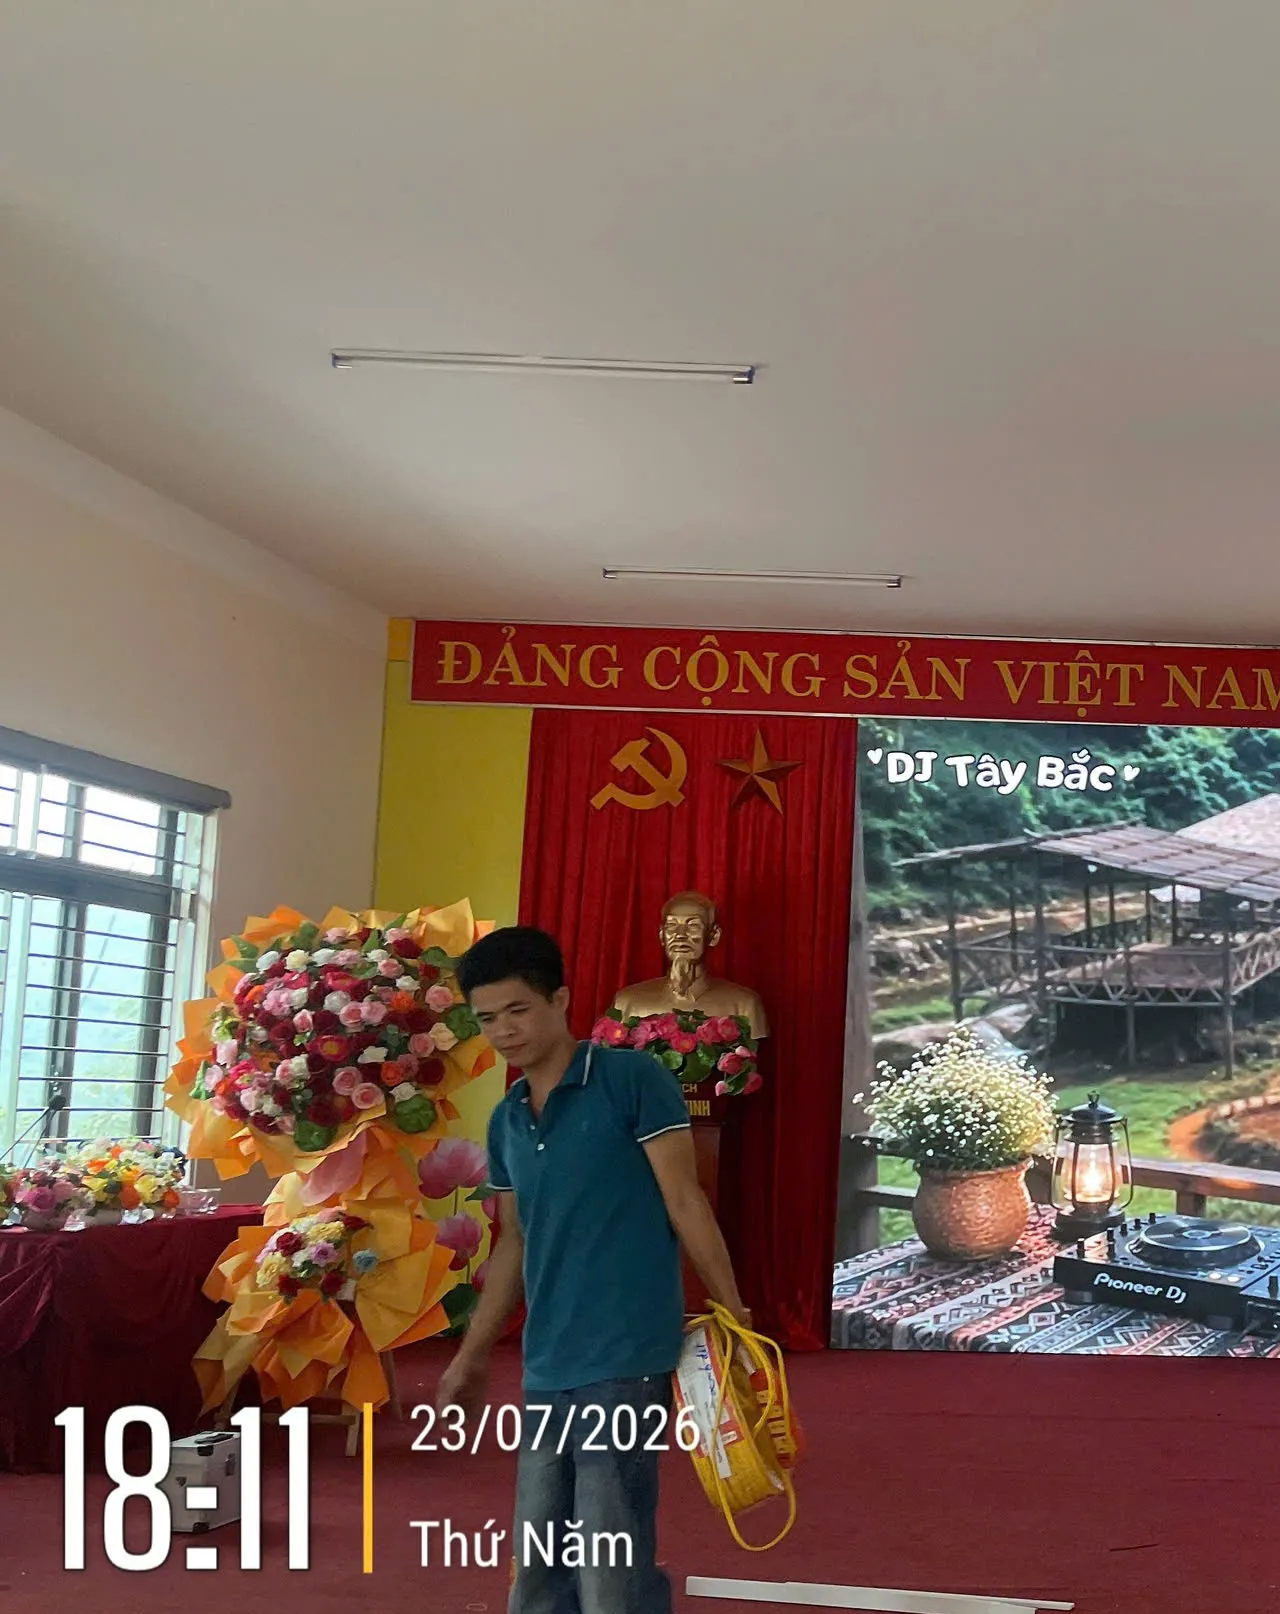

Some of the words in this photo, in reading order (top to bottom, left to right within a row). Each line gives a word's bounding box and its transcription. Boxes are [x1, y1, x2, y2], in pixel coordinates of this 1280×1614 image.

[438, 626, 623, 689] ĐẢNG
[642, 634, 825, 706] CỘNG
[842, 639, 968, 702] SẢN
[993, 649, 1145, 718] VIỆT
[886, 750, 939, 784] DJ
[944, 753, 1028, 795] Tây
[1036, 748, 1116, 792] Bắc
[685, 1099, 711, 1116] INH
[1093, 1272, 1163, 1296] Pioneer
[1165, 1285, 1187, 1304] DJ
